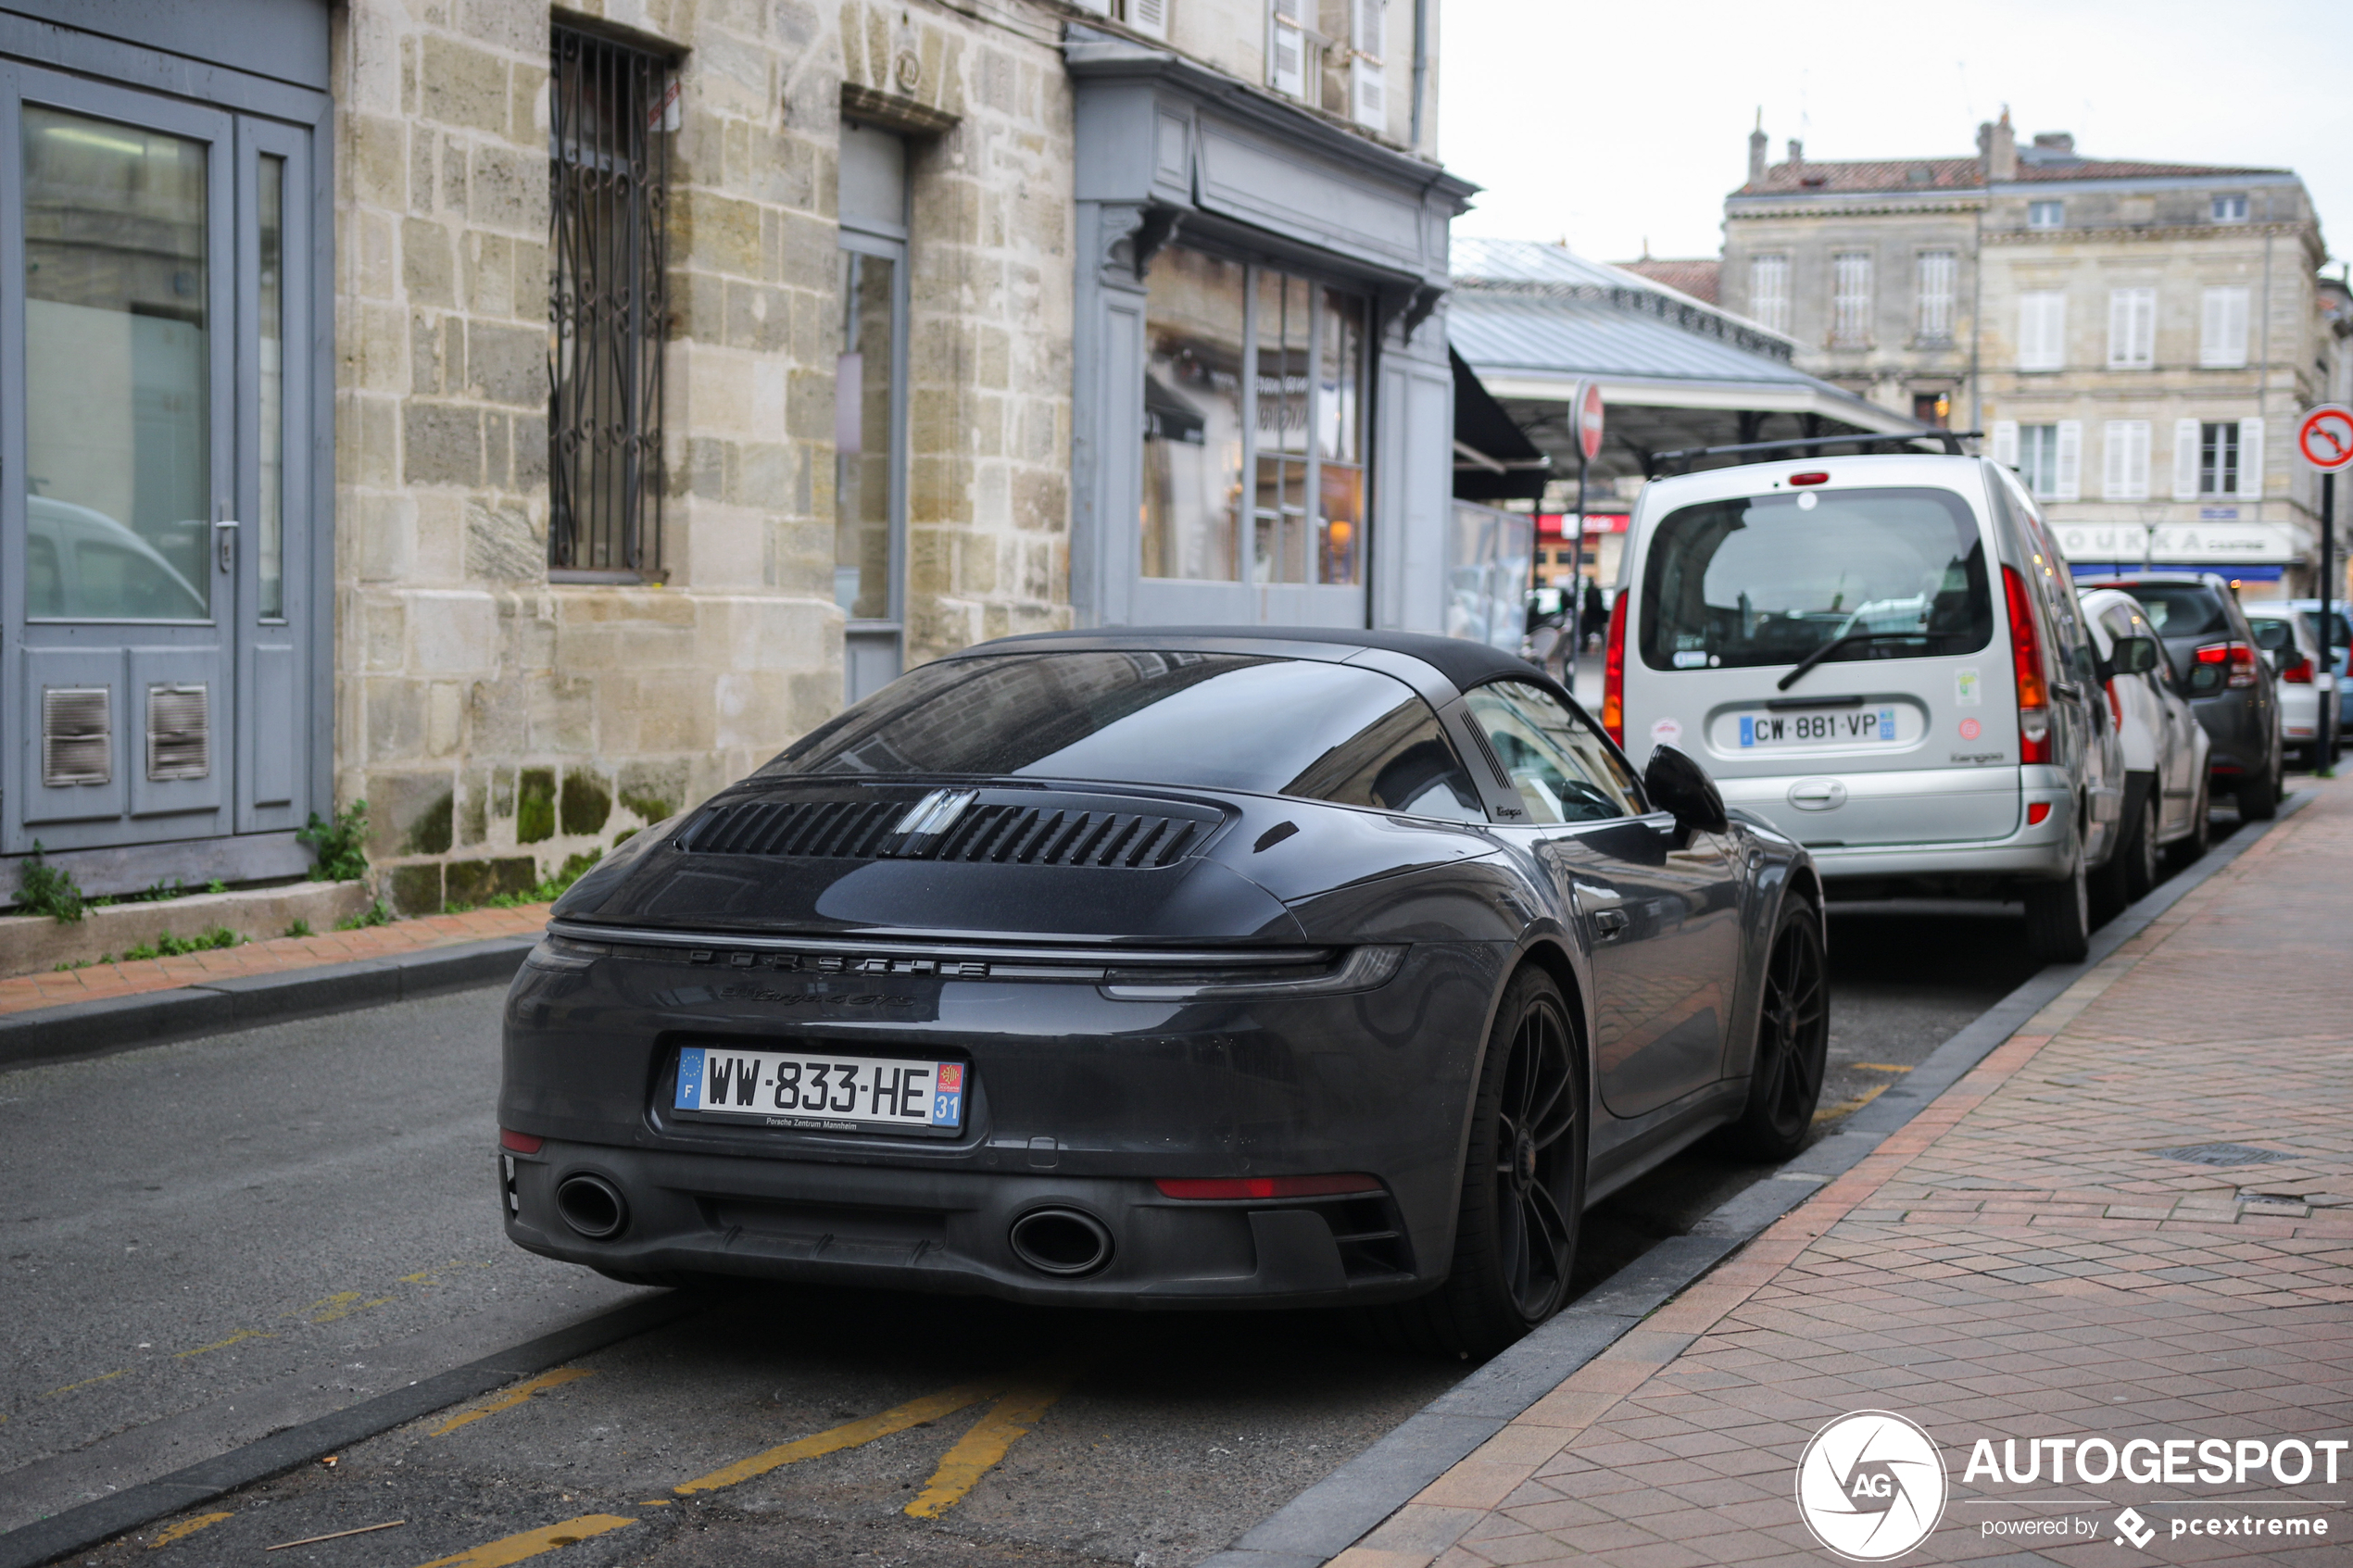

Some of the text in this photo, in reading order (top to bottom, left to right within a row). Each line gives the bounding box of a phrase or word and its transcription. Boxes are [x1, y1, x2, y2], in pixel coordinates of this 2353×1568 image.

[689, 950, 989, 978] PORSCHE
[684, 1085, 693, 1098] F
[710, 1057, 929, 1118] WW-833-HE
[936, 1095, 959, 1120] 31
[766, 1117, 857, 1130] Porsche Zentrum Mannheim
